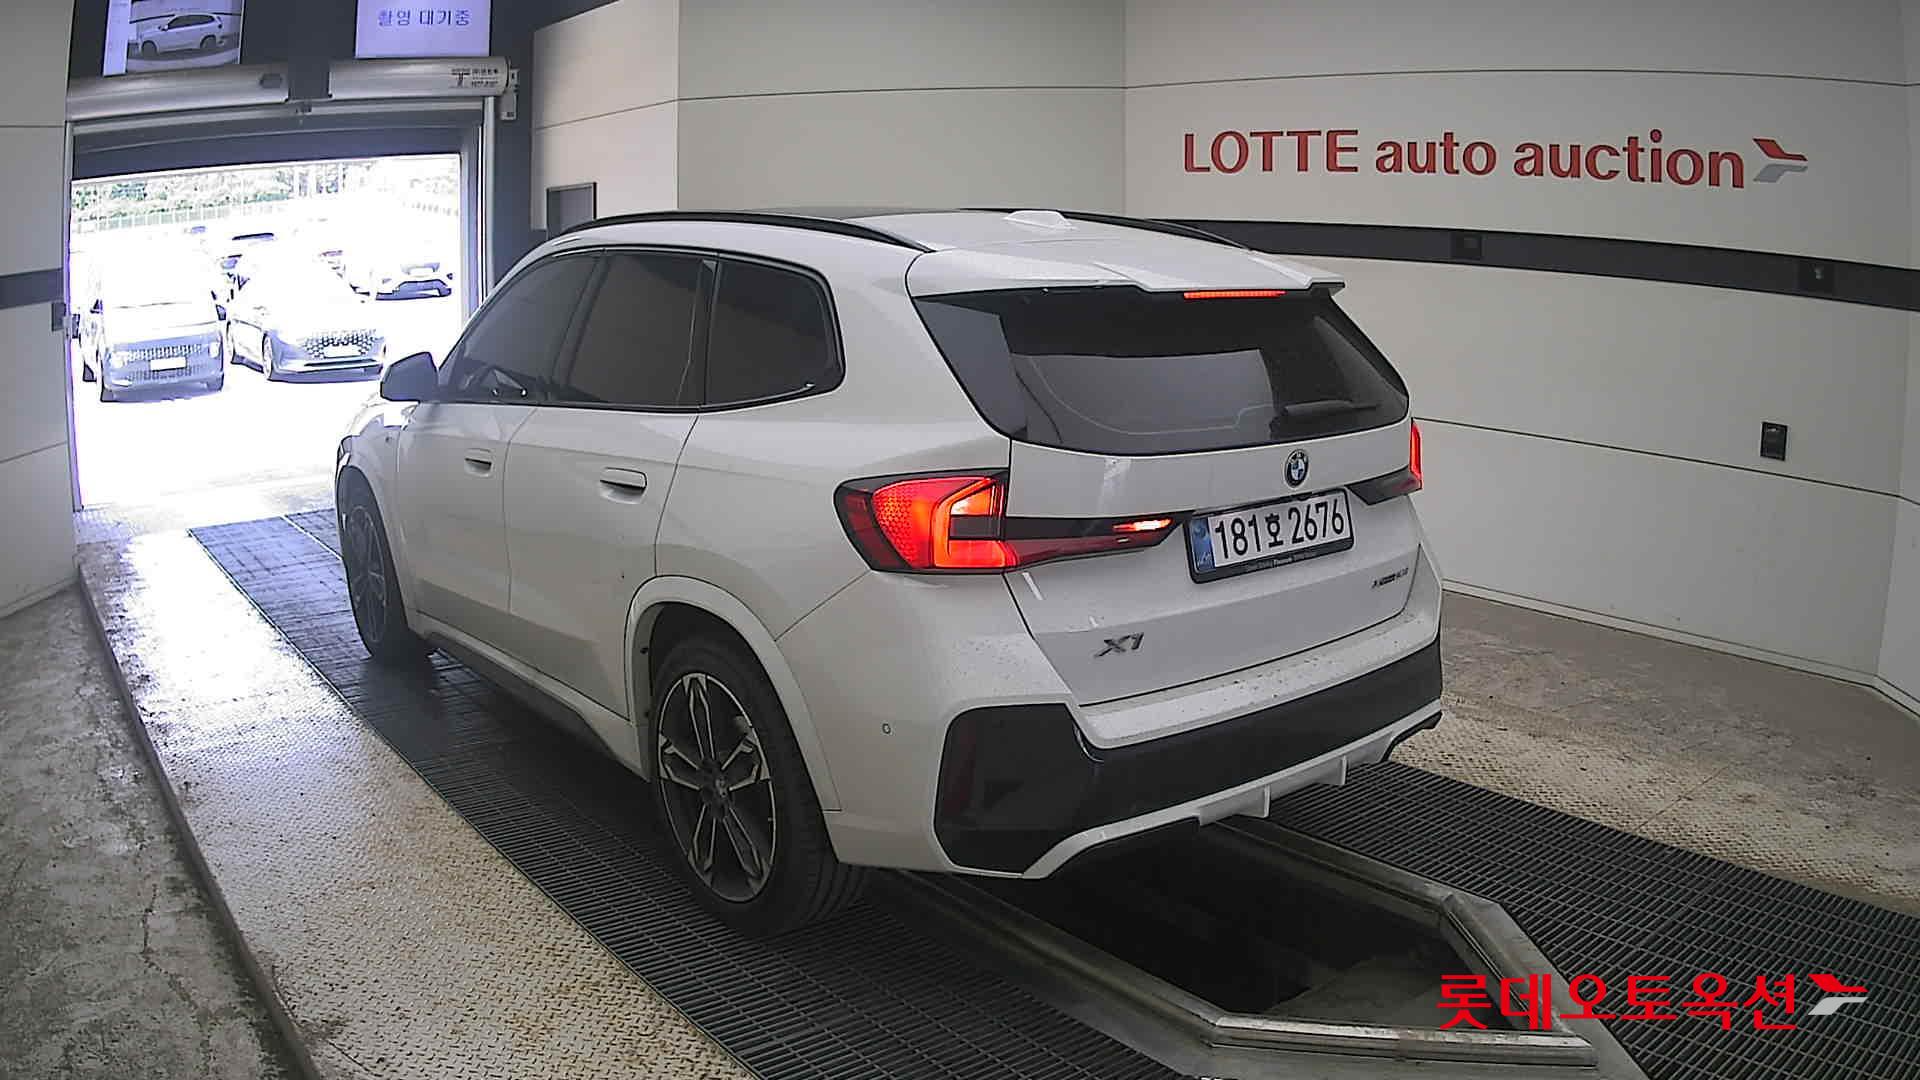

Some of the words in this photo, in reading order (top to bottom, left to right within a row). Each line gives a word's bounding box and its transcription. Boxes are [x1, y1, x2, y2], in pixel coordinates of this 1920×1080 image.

[419, 9, 471, 27] 대기중
[1184, 130, 1359, 173] LOTTE
[1375, 132, 1497, 175] auto
[1513, 129, 1744, 189] auction
[1215, 512, 1284, 560] 181호
[1287, 499, 1345, 544] 2676
[1094, 632, 1144, 658] X1
